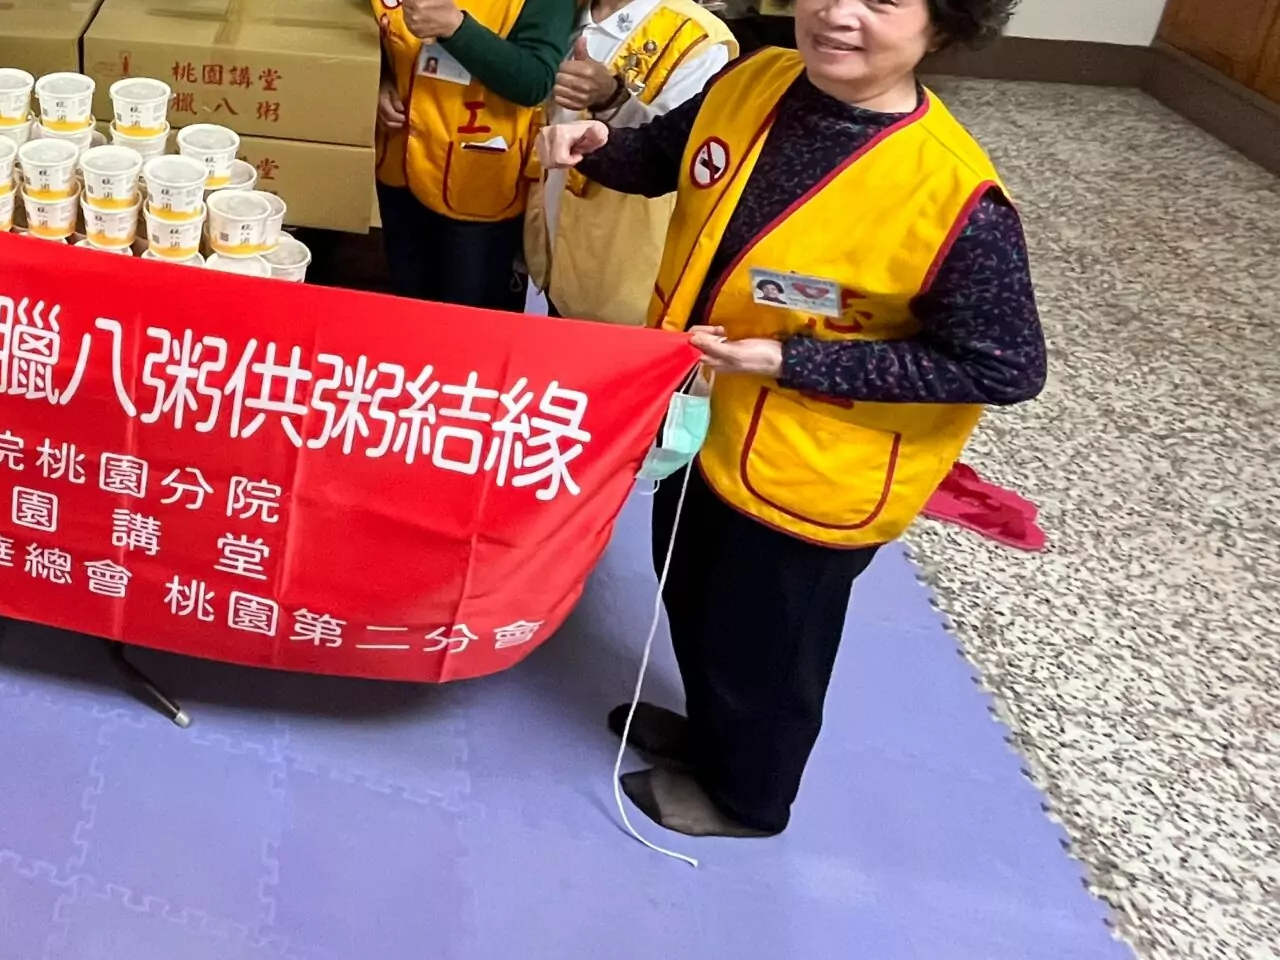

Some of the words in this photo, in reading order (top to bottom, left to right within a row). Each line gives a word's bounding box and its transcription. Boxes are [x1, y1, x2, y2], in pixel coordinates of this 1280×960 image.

[171, 61, 283, 91] 桃園講堂
[457, 101, 491, 134] 工
